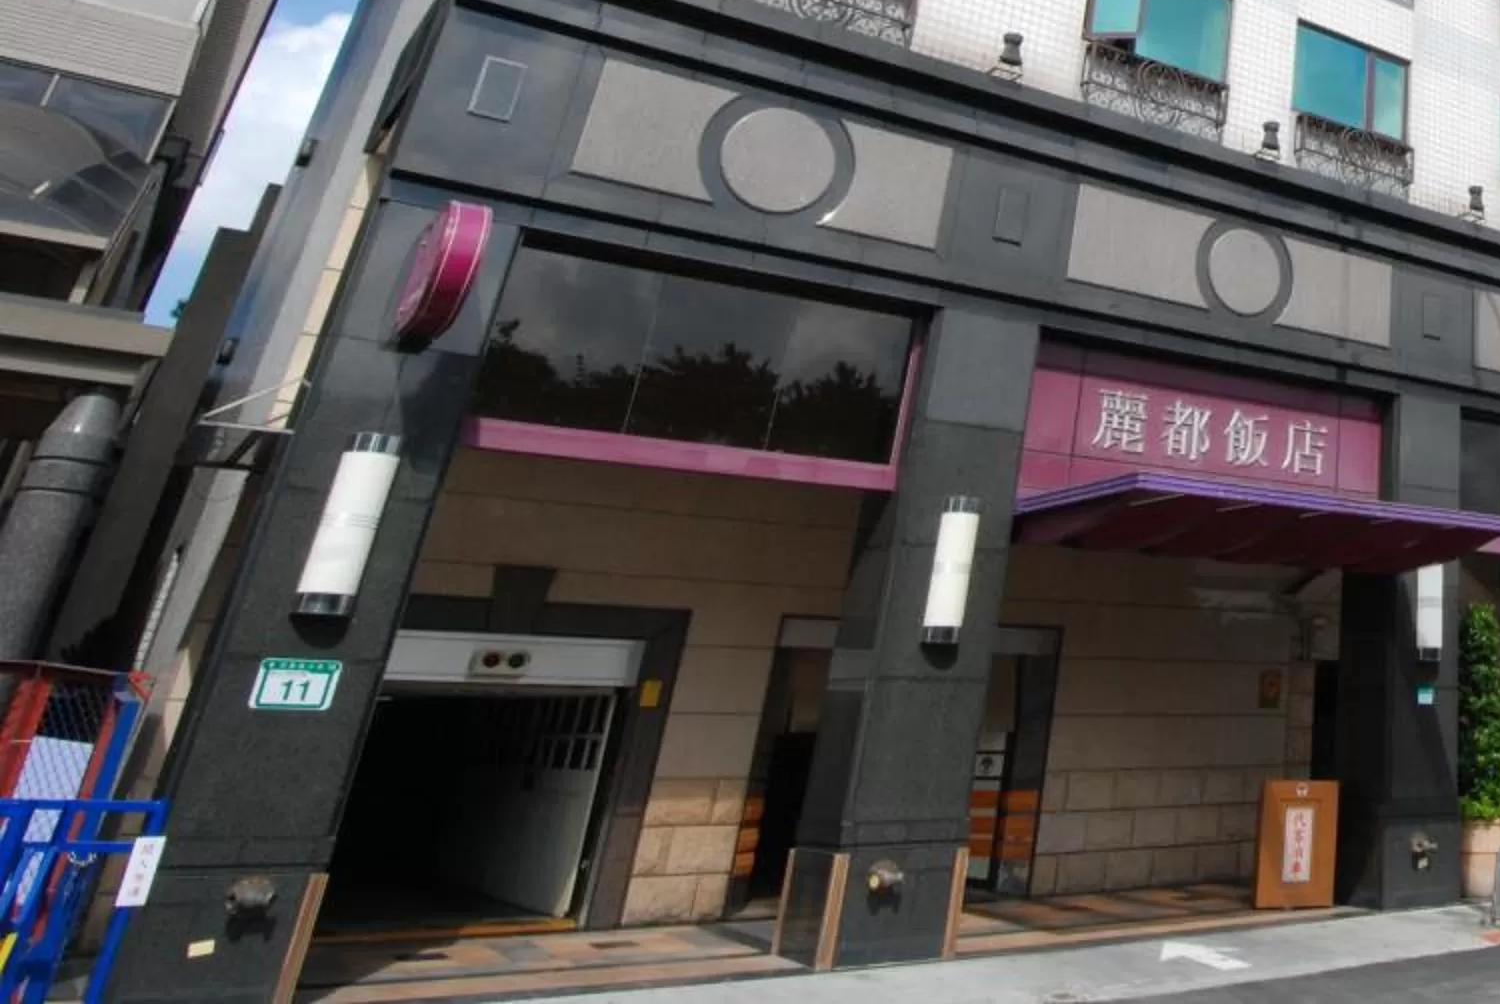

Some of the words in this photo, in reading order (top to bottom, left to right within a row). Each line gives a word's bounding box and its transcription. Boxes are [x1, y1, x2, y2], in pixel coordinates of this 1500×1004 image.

[1092, 387, 1329, 477] 麗都飯店
[280, 679, 311, 702] 11
